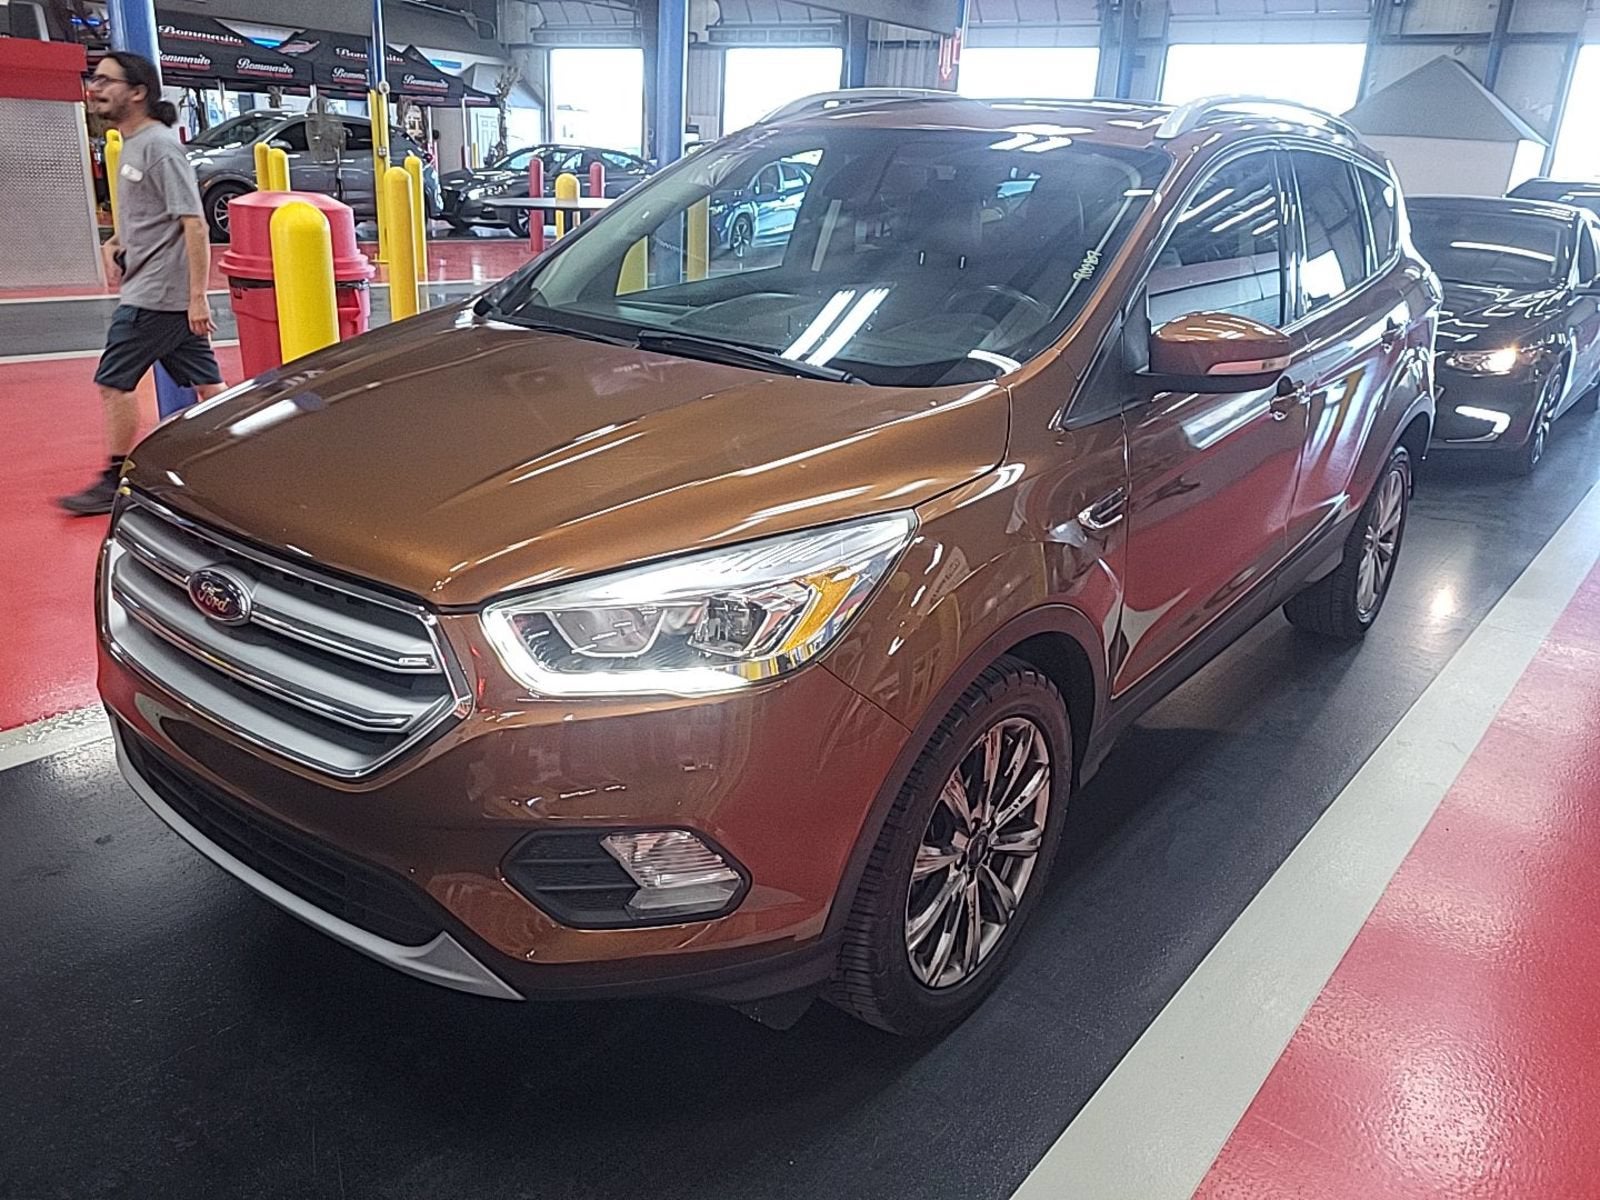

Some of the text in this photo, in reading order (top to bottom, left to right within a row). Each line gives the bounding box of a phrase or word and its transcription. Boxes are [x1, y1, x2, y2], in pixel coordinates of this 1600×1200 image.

[158, 25, 243, 44] Bommarito
[159, 50, 211, 65] ommarito
[236, 57, 294, 74] Bommarito
[197, 581, 231, 613] Ford
